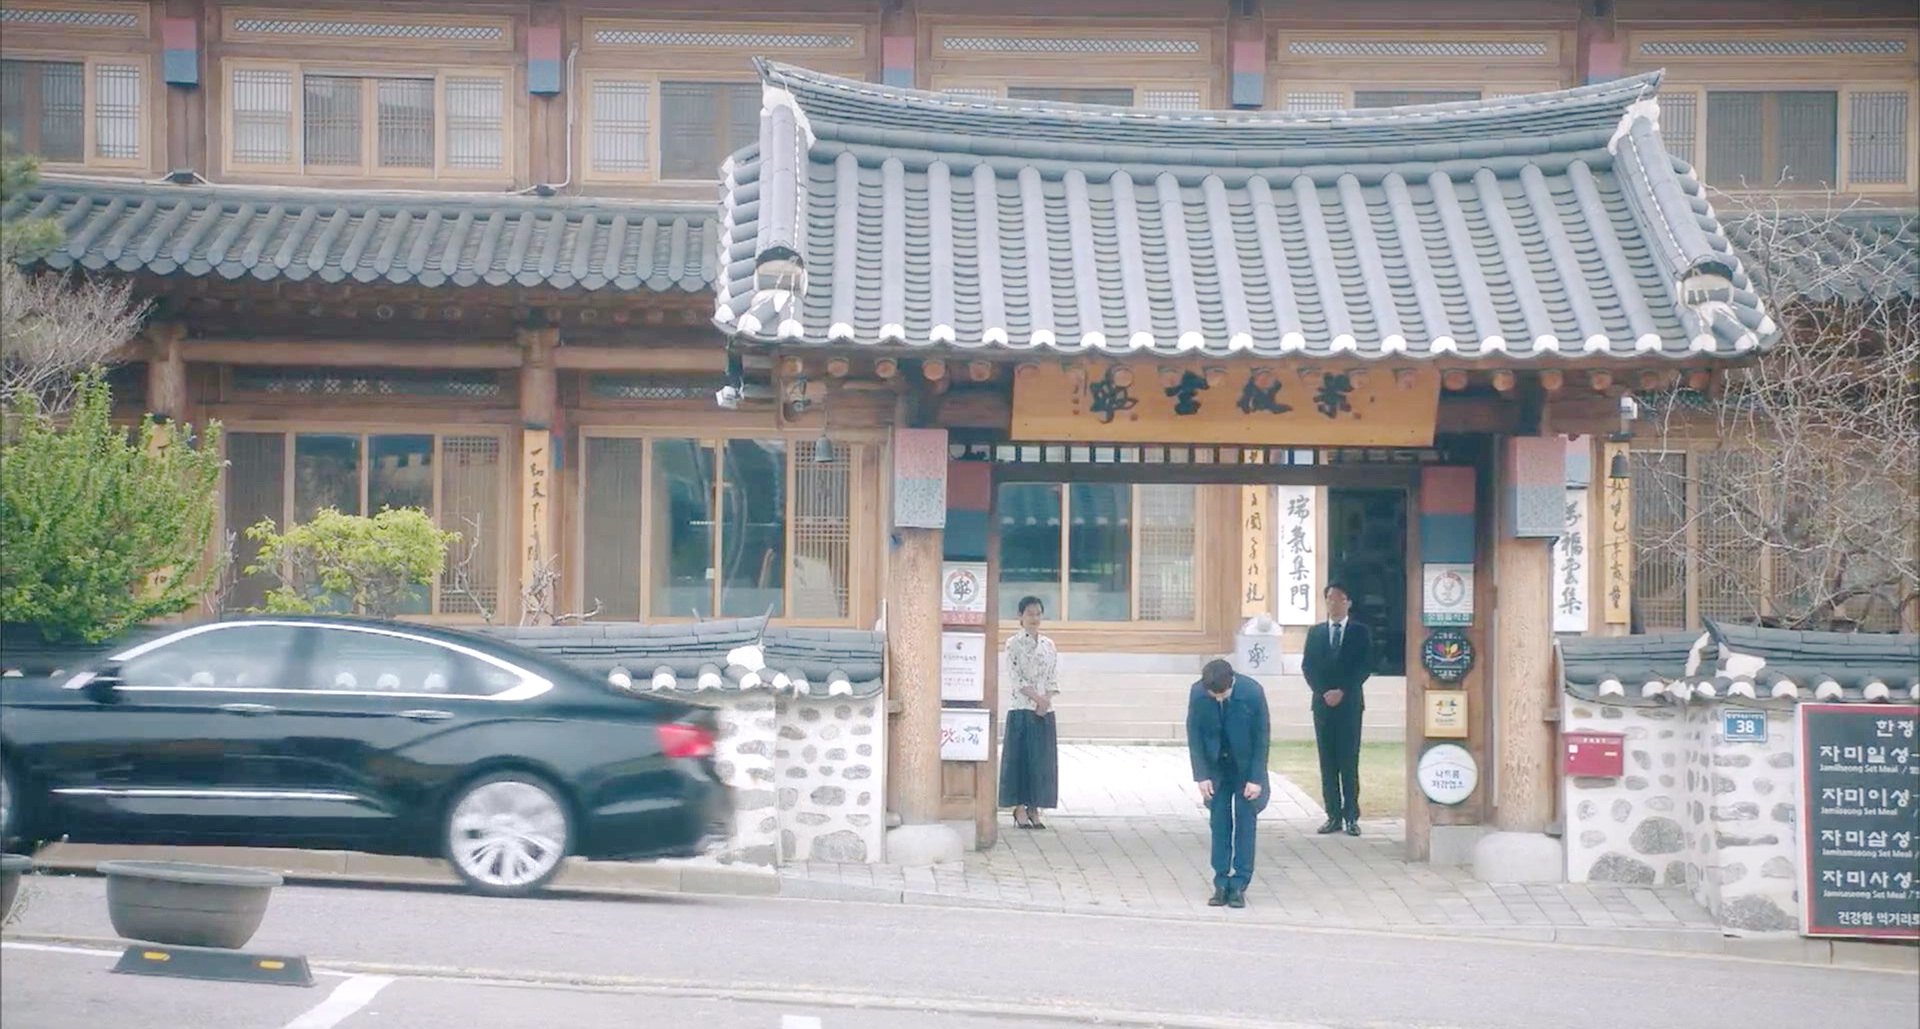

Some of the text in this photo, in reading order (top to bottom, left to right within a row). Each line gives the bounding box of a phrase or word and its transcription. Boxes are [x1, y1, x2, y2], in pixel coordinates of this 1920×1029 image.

[1735, 719, 1755, 734] 38
[1819, 745, 1909, 764] 자미일성
[1864, 764, 1878, 773] Set
[1878, 765, 1899, 774] Meal
[1821, 787, 1910, 808] 자미이성
[1863, 807, 1877, 815] Set
[1877, 807, 1898, 816] Meal
[1821, 829, 1911, 849] 자미삼성
[1822, 869, 1913, 889] 자미사성
[1837, 911, 1874, 926] 건강한
